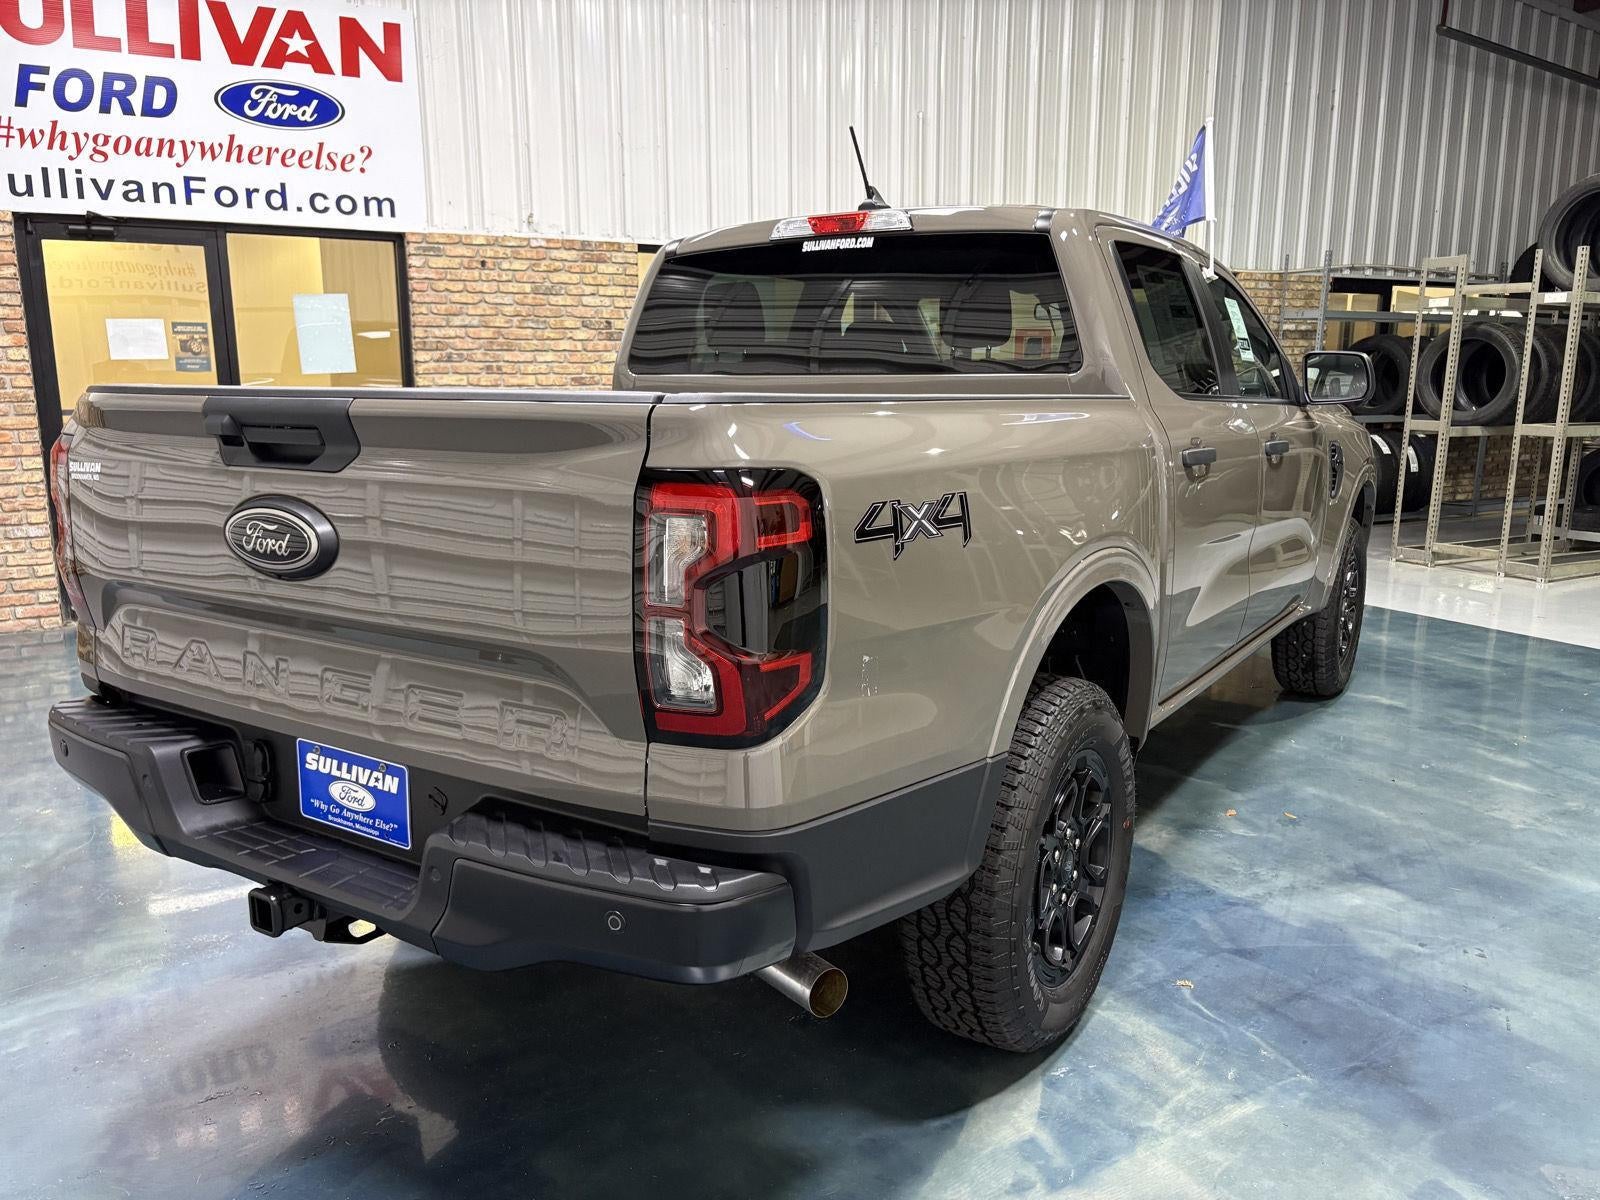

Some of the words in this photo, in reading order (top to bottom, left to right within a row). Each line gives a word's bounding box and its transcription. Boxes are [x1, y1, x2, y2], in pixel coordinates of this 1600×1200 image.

[14, 63, 178, 118] FORD
[242, 83, 319, 123] Ford
[0, 115, 373, 173] #whygoanywhereelse?
[7, 166, 397, 218] ullivanFord.com
[802, 236, 875, 252] SULLIVANFORD.COM
[69, 461, 102, 473] SULLIVAN
[242, 520, 291, 556] Ford
[122, 622, 572, 761] RANGER
[305, 752, 399, 795] SULLIVAN
[329, 803, 341, 814] Go
[341, 808, 374, 826] Anywhere
[338, 785, 367, 807] Ford
